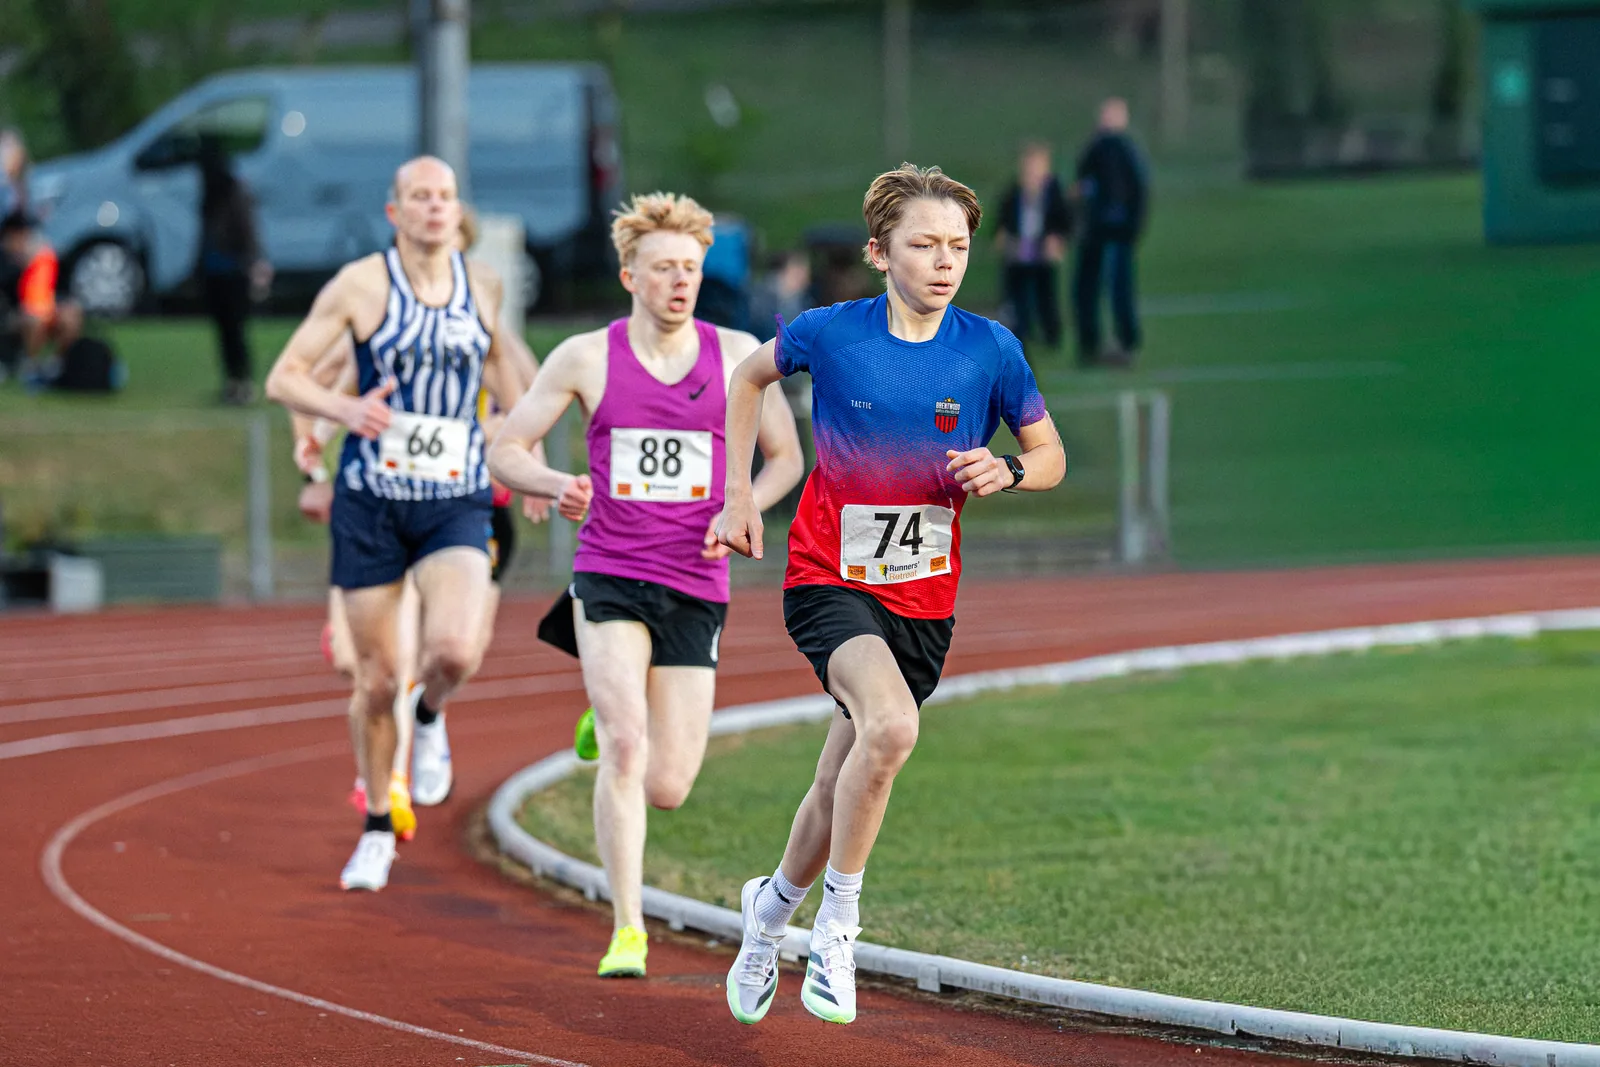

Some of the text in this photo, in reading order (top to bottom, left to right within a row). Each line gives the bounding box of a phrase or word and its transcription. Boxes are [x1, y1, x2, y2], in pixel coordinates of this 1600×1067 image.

[851, 400, 872, 410] TACTIC
[408, 424, 443, 458] 66
[639, 437, 682, 477] 88
[873, 512, 923, 558] 74
[889, 560, 920, 572] Runners'
[889, 570, 917, 580] Retreat
